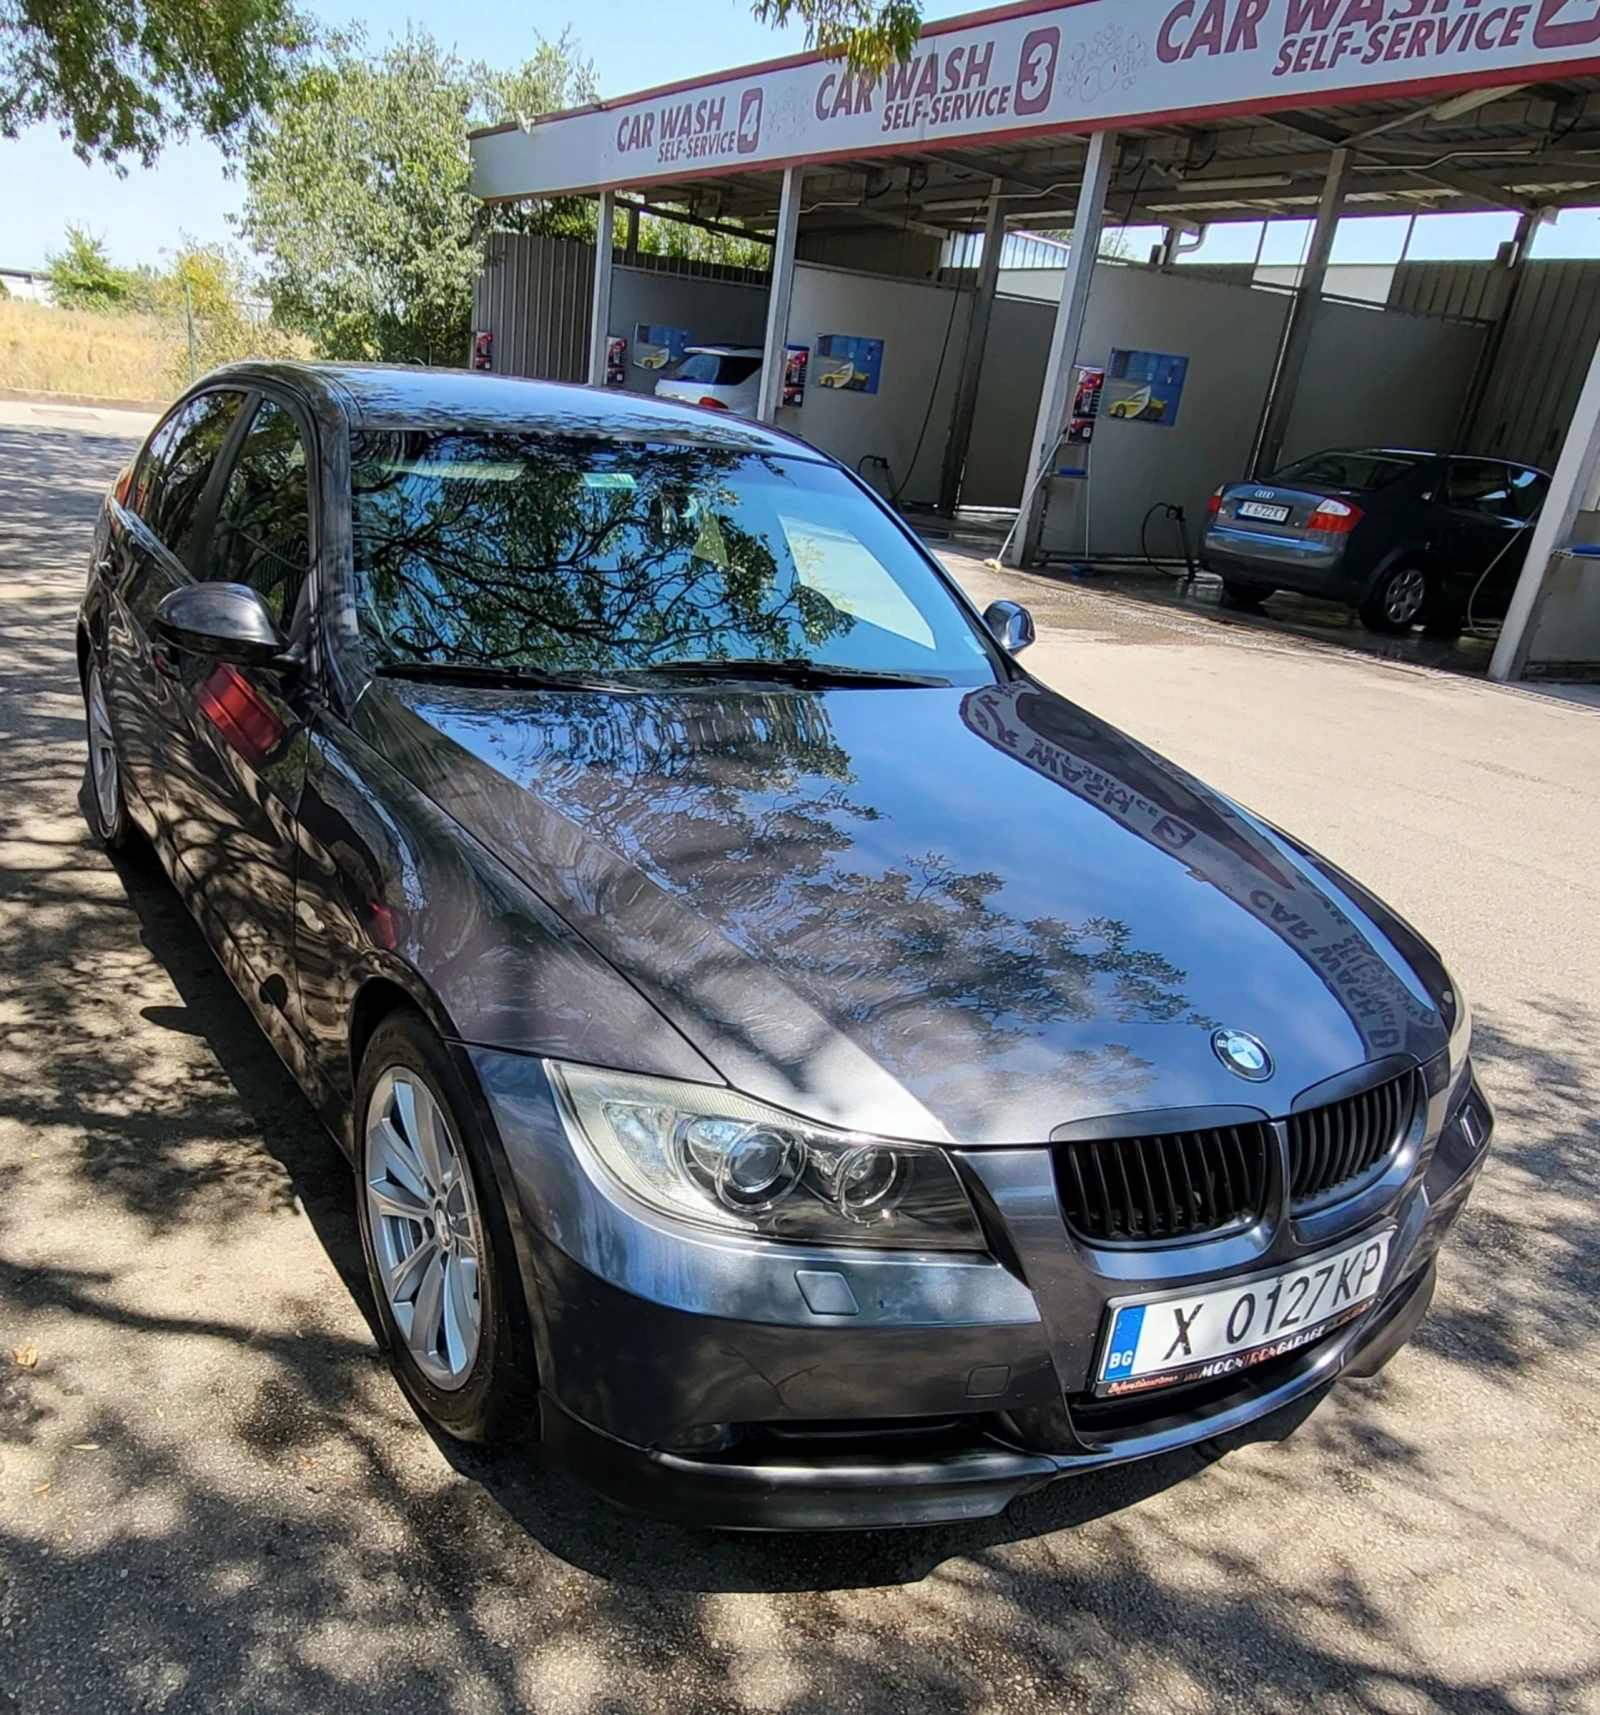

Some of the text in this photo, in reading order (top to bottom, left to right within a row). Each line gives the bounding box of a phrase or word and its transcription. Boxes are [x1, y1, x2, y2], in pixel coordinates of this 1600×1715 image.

[1156, 0, 1480, 63] CAR WA
[1272, 4, 1533, 76] SELF-SERVICE
[815, 41, 995, 121] CAR WASH
[881, 85, 1011, 132] SELF-SERVICE
[617, 96, 726, 153] CAR WASH
[657, 130, 736, 163] SELF-SERVICE
[1108, 1348, 1133, 1370] BG
[1161, 1303, 1205, 1362] X
